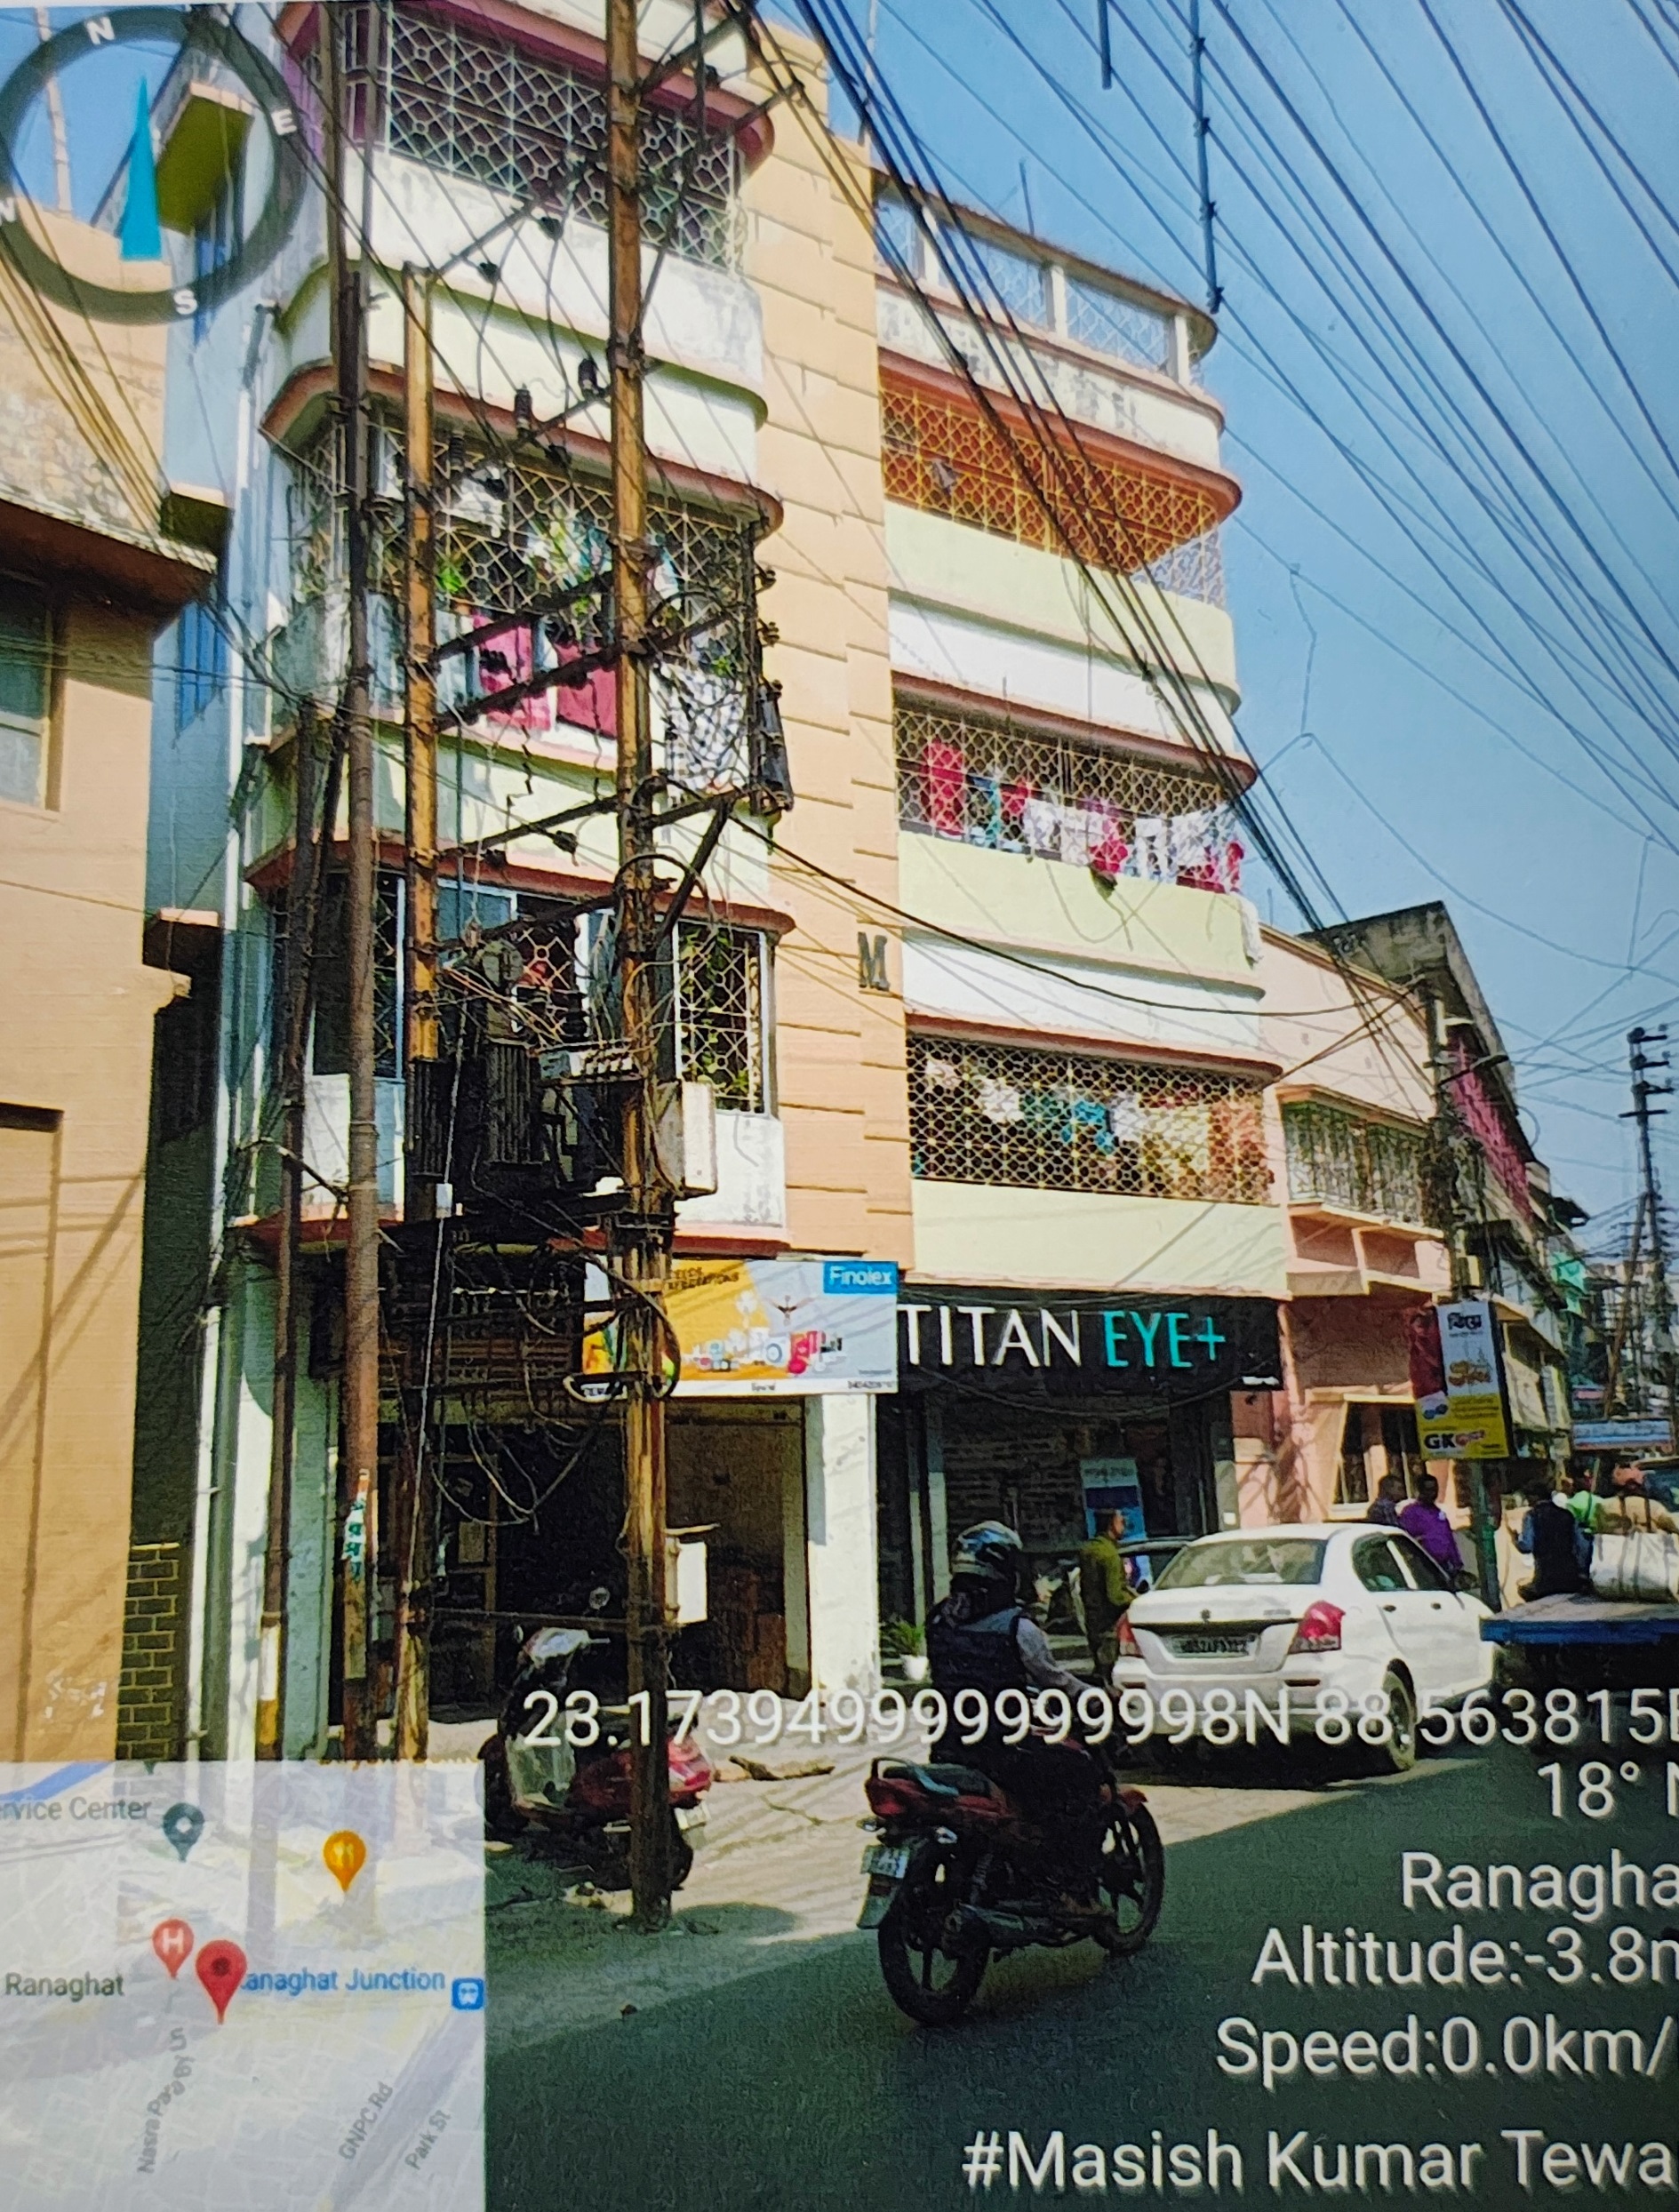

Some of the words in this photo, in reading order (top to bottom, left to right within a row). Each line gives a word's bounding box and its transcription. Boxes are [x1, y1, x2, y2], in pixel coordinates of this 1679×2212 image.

[829, 1266, 892, 1285] Finolex
[897, 1305, 1082, 1368] TITAN
[1102, 1310, 1226, 1368] EYE+
